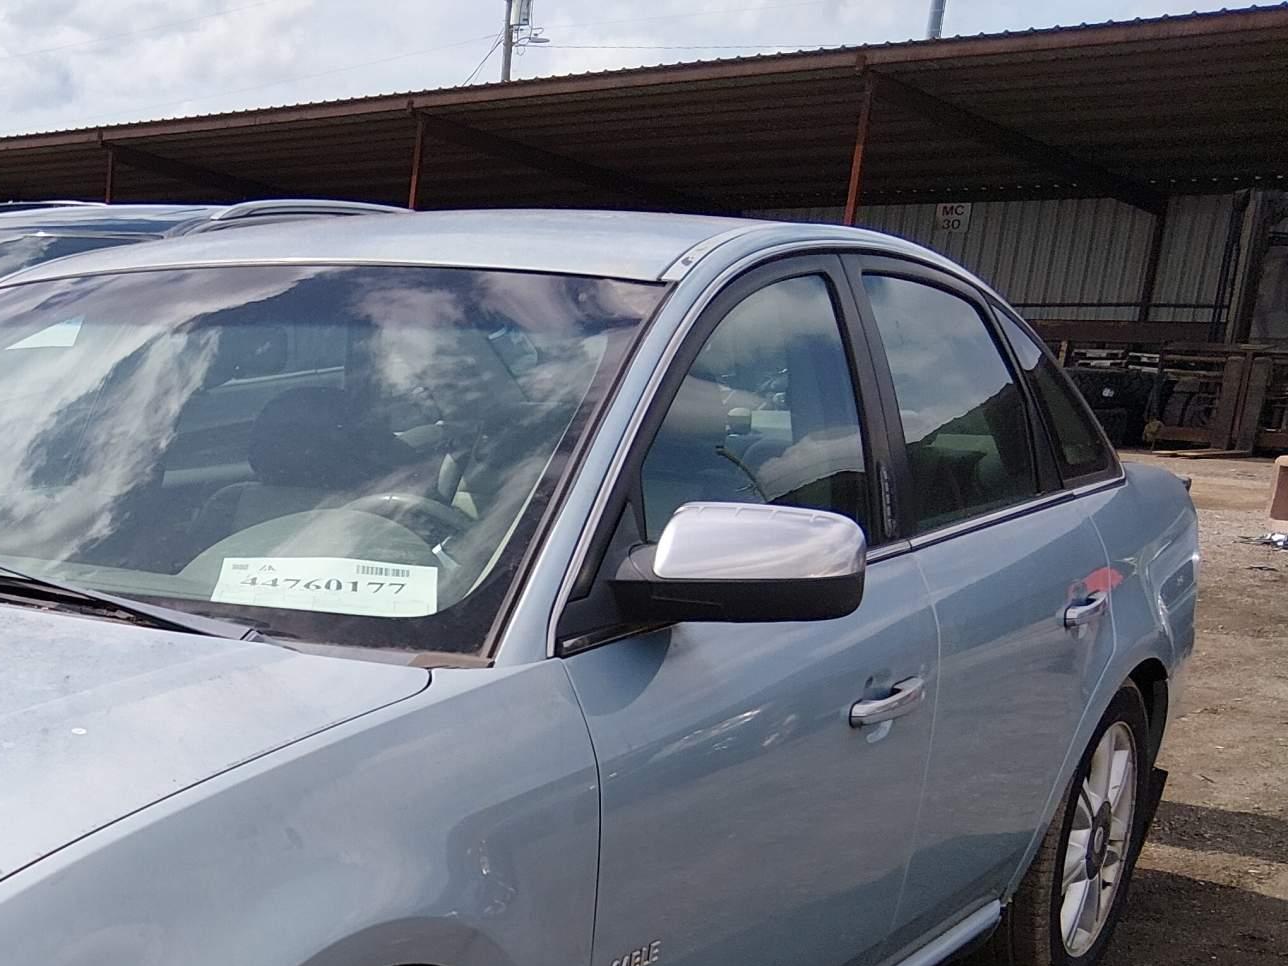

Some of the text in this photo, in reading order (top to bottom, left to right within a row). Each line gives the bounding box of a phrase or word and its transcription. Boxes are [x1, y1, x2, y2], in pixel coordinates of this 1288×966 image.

[942, 204, 965, 216] MC
[942, 219, 961, 230] 30
[240, 576, 407, 594] 44760177
